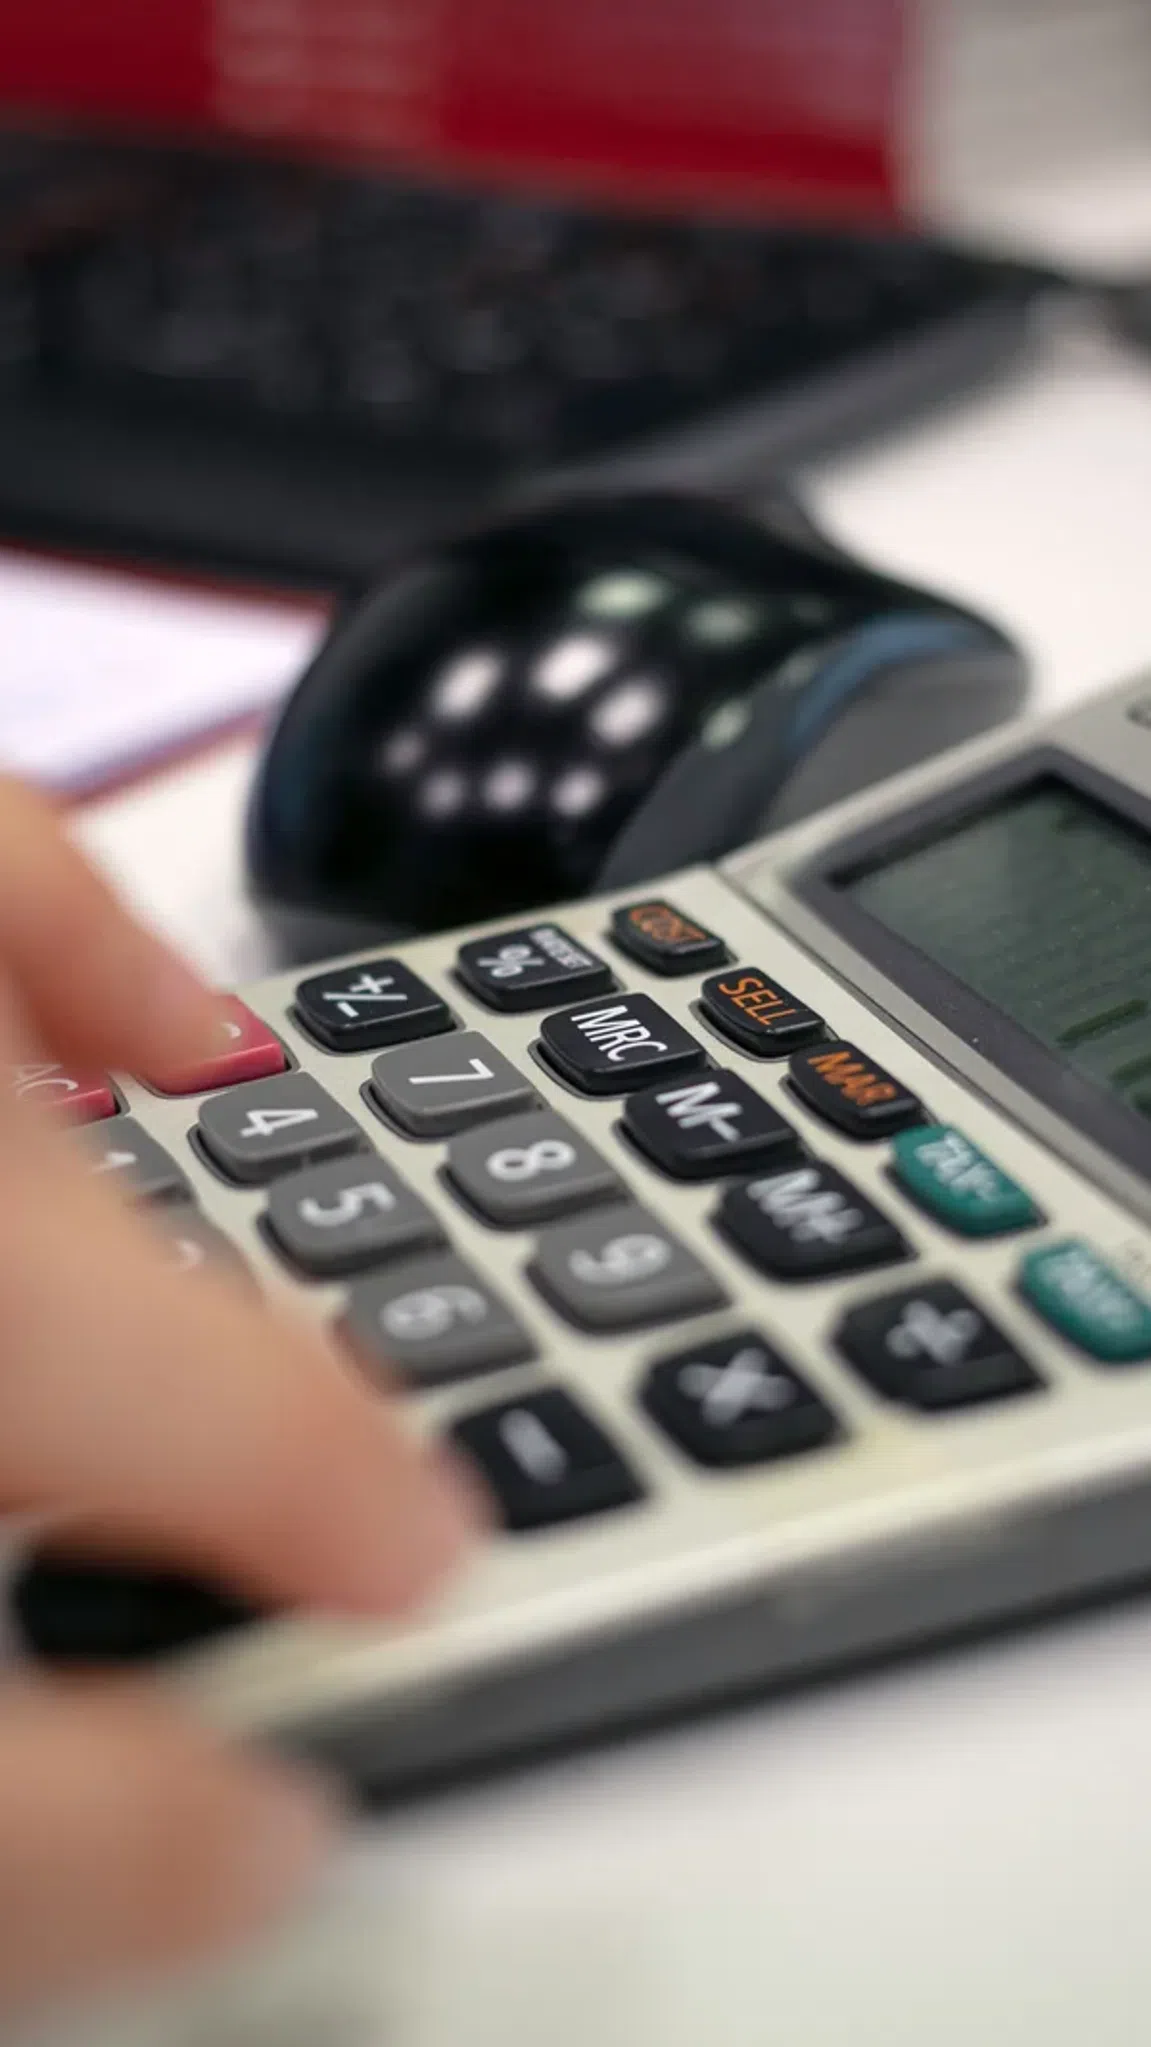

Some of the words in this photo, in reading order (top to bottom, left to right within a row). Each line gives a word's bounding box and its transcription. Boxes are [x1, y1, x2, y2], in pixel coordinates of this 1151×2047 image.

[719, 977, 797, 1025] SELL
[571, 1005, 667, 1062] MRC
[408, 1058, 494, 1084] 7
[808, 1050, 897, 1106] MAR
[240, 1108, 319, 1138] 4
[656, 1081, 743, 1142] M-
[485, 1139, 577, 1182] 8
[300, 1182, 396, 1227] 5
[568, 1233, 671, 1285] 9
[378, 1285, 488, 1340] 6
